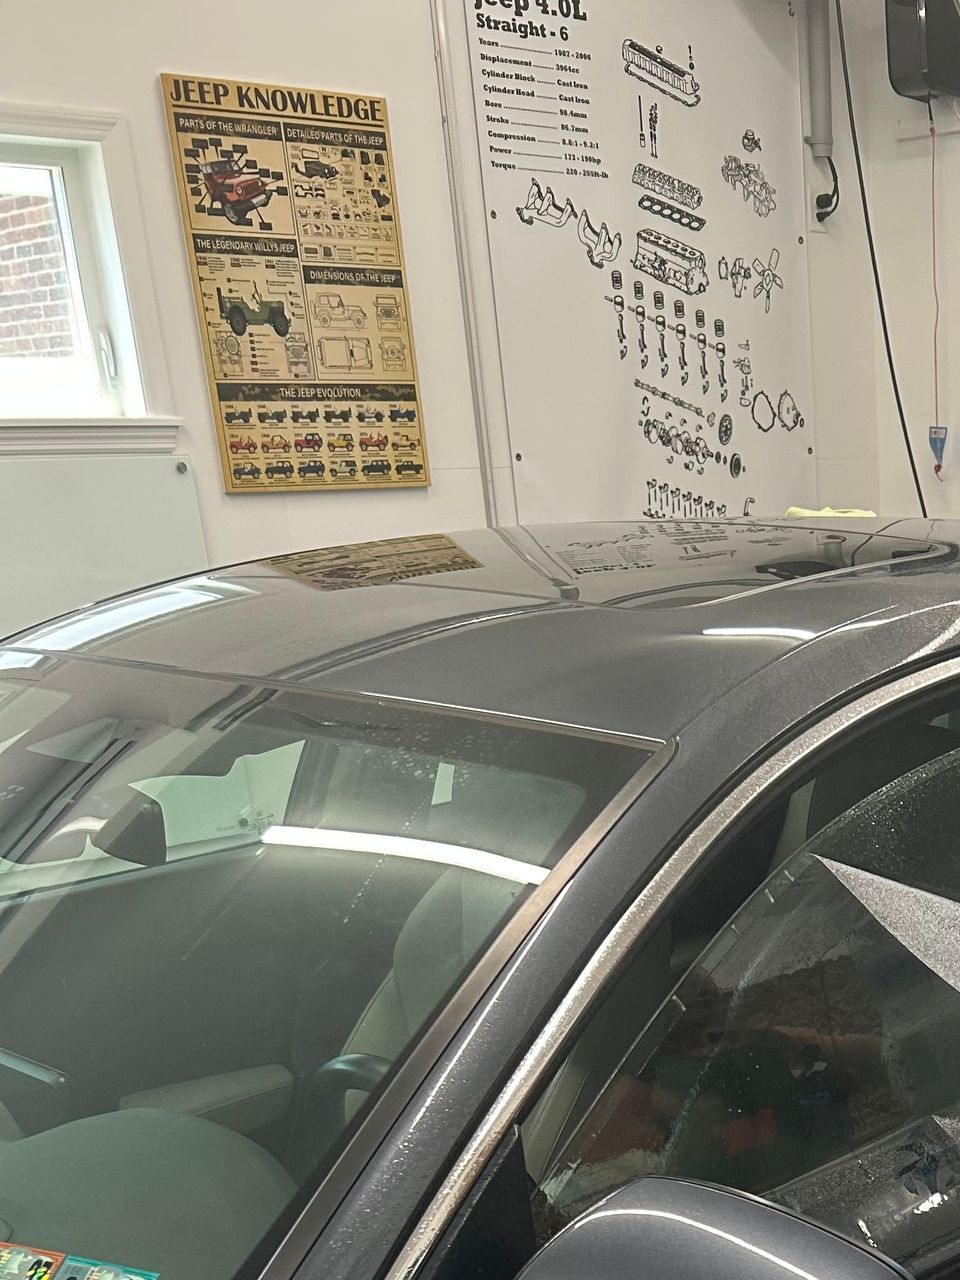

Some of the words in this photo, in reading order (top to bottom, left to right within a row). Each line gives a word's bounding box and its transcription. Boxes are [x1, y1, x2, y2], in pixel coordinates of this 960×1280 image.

[535, 0, 588, 21] 4.0L
[476, 12, 547, 39] Straight
[559, 26, 569, 41] 6
[478, 37, 499, 47] Years
[480, 53, 532, 67] Displacement
[555, 64, 580, 74] 3964cc
[481, 68, 514, 80] Cylinder
[514, 73, 536, 83] Block
[557, 79, 573, 88] Cast
[573, 81, 588, 90] Iron
[171, 79, 229, 105] JEEP
[236, 85, 384, 122] KNOWLEDGE
[483, 84, 515, 95] Cylinder
[516, 88, 535, 98] Head
[558, 94, 574, 103] Cast
[574, 96, 590, 105] Iron
[485, 100, 502, 108] Bore
[486, 115, 509, 124] Stroke
[179, 118, 204, 130] PARTS
[206, 120, 217, 130] OF
[218, 122, 234, 132] THE
[234, 124, 277, 136] WRANGLER
[287, 128, 320, 140] DETAILED
[321, 131, 340, 142] PARTS
[341, 133, 353, 143] OF
[354, 134, 368, 144] THE
[368, 135, 384, 146] JEEP
[487, 130, 536, 142] Compression
[489, 145, 512, 154] Power
[490, 160, 516, 171] Torque
[196, 239, 211, 249] THE
[212, 240, 254, 251] LEGENDARY
[254, 242, 279, 252] WILLYS
[279, 244, 295, 253] JEEP
[310, 270, 355, 281] DIMENSIONS
[355, 272, 366, 281] OF
[366, 273, 380, 282] THE
[380, 274, 396, 284] JEEP
[280, 387, 296, 398] THE
[298, 387, 316, 398] JEEP
[317, 387, 361, 398] EVOLUTION
